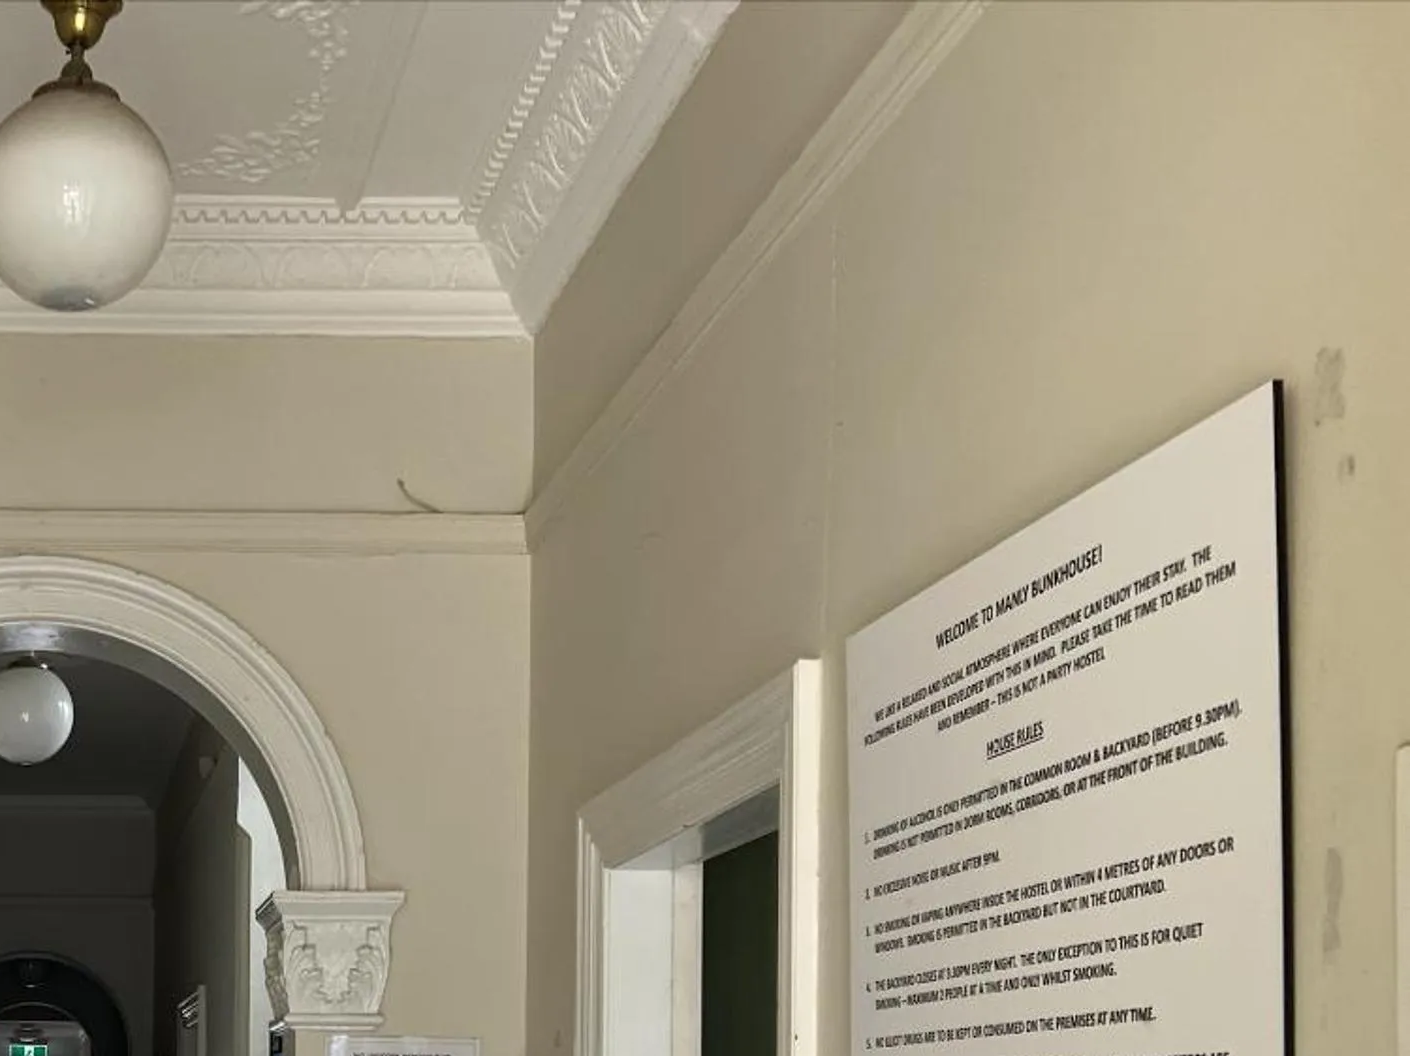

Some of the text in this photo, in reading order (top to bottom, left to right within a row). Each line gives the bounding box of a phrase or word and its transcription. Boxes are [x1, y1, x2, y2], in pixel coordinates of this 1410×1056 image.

[935, 542, 1103, 650] WELCOME TO MANLY BUNKHOUSE!
[1083, 543, 1211, 624] CAN ENJOY THEIR STAY. THE
[1092, 616, 1113, 644] TAKE
[1114, 607, 1132, 634] THE
[1134, 595, 1158, 625] TIME
[1160, 587, 1174, 613] TO
[1174, 574, 1203, 607] READ
[1205, 558, 1237, 593] THEM
[1072, 644, 1105, 674] HOSTEL
[986, 719, 1043, 760] HOUSE RULES
[1092, 747, 1101, 767] &
[1101, 729, 1150, 763] BACKYARD
[1151, 714, 1193, 747] (BEFORE
[1194, 697, 1241, 732] 9.30PM).
[1088, 769, 1106, 791] THE
[1106, 758, 1137, 786] FRONT
[1138, 753, 1152, 776] OF
[1154, 746, 1173, 771] THE
[1174, 728, 1230, 764] BUILDING.
[1096, 866, 1103, 884] 4
[1103, 857, 1140, 882] METRES
[1141, 854, 1155, 874] OF
[1156, 848, 1177, 870] ANY
[1178, 839, 1216, 865] DOORS
[1217, 834, 1234, 856] OR
[1090, 890, 1106, 909] THE
[1108, 877, 1166, 905] COURTYARD.
[1104, 936, 1118, 954] TO
[1118, 932, 1139, 952] THIS
[1139, 930, 1149, 948] IS
[1150, 927, 1170, 946] FOR
[1171, 921, 1203, 943] QUIET
[1096, 1004, 1158, 1027] AT ANY TIME.
